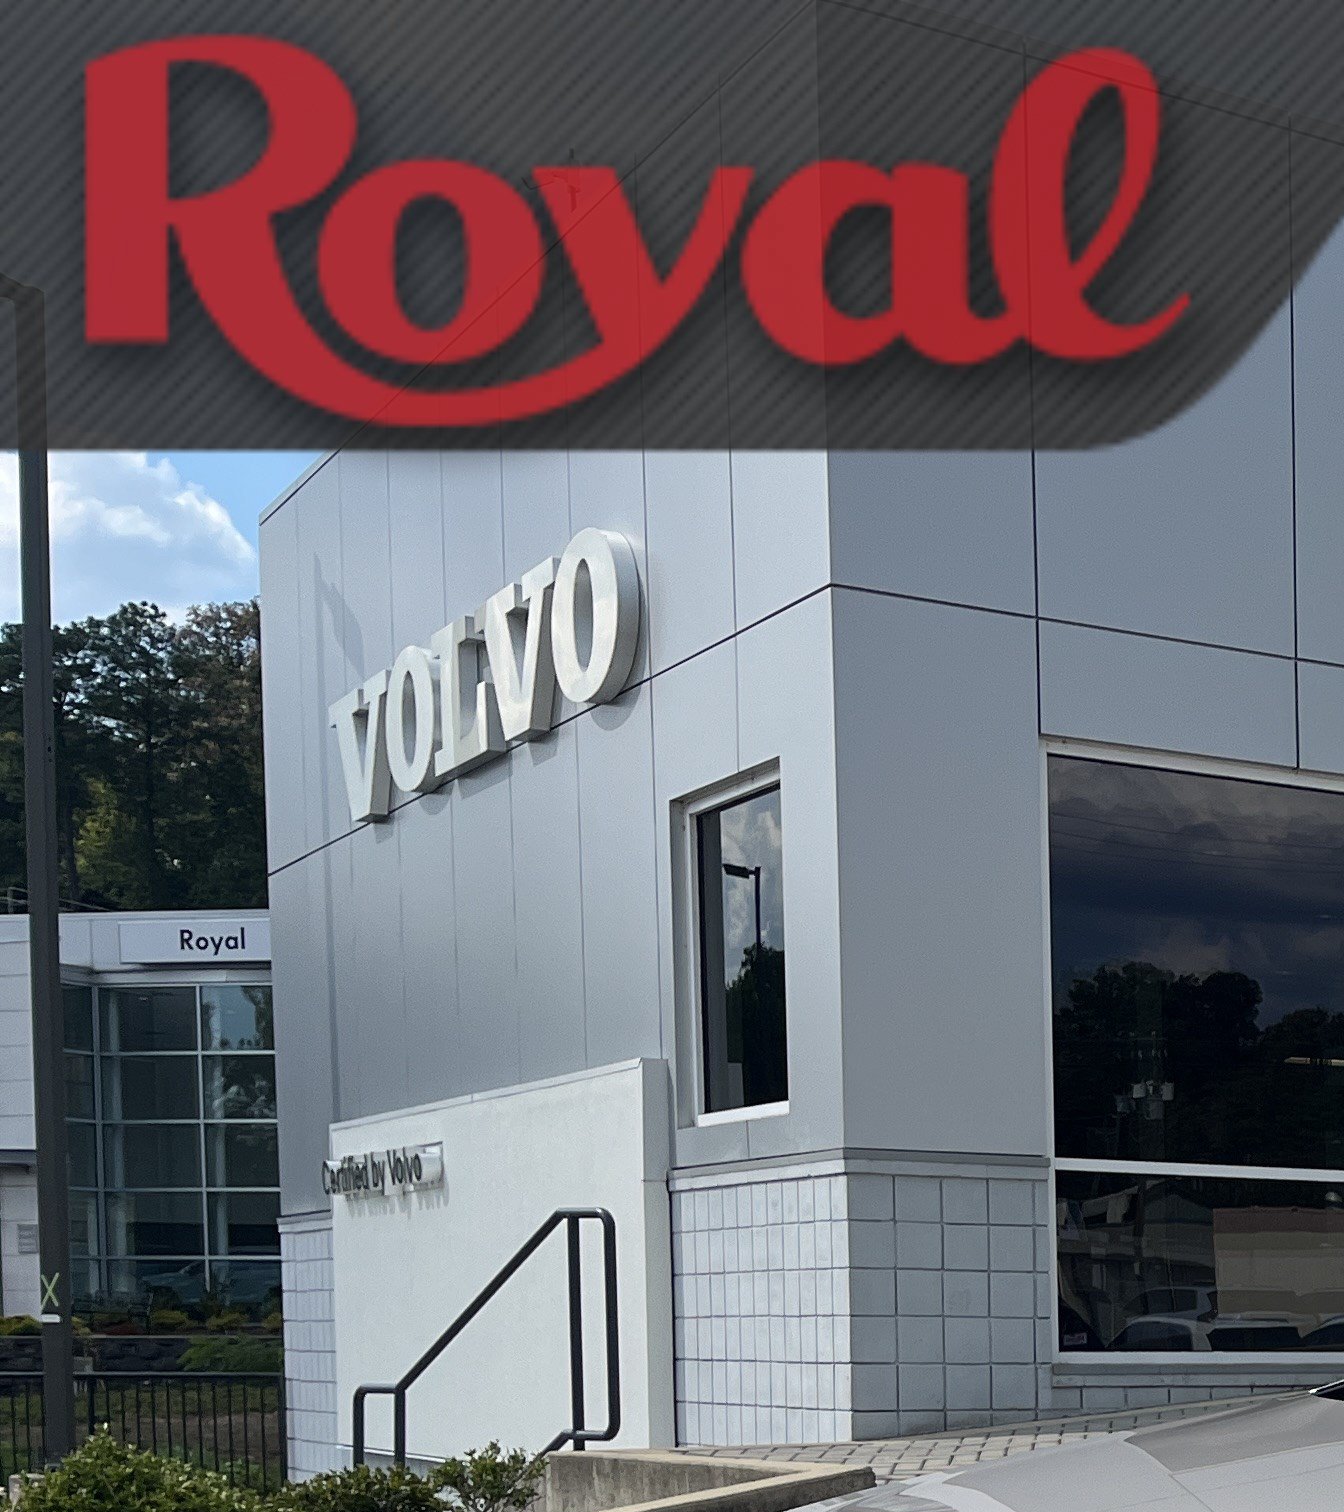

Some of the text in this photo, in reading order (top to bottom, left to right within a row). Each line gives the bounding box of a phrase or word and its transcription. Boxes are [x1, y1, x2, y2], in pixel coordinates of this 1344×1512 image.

[328, 526, 634, 822] VOLVO
[179, 927, 245, 956] Royal
[371, 1151, 385, 1196] by
[386, 1147, 422, 1186] Volvo
